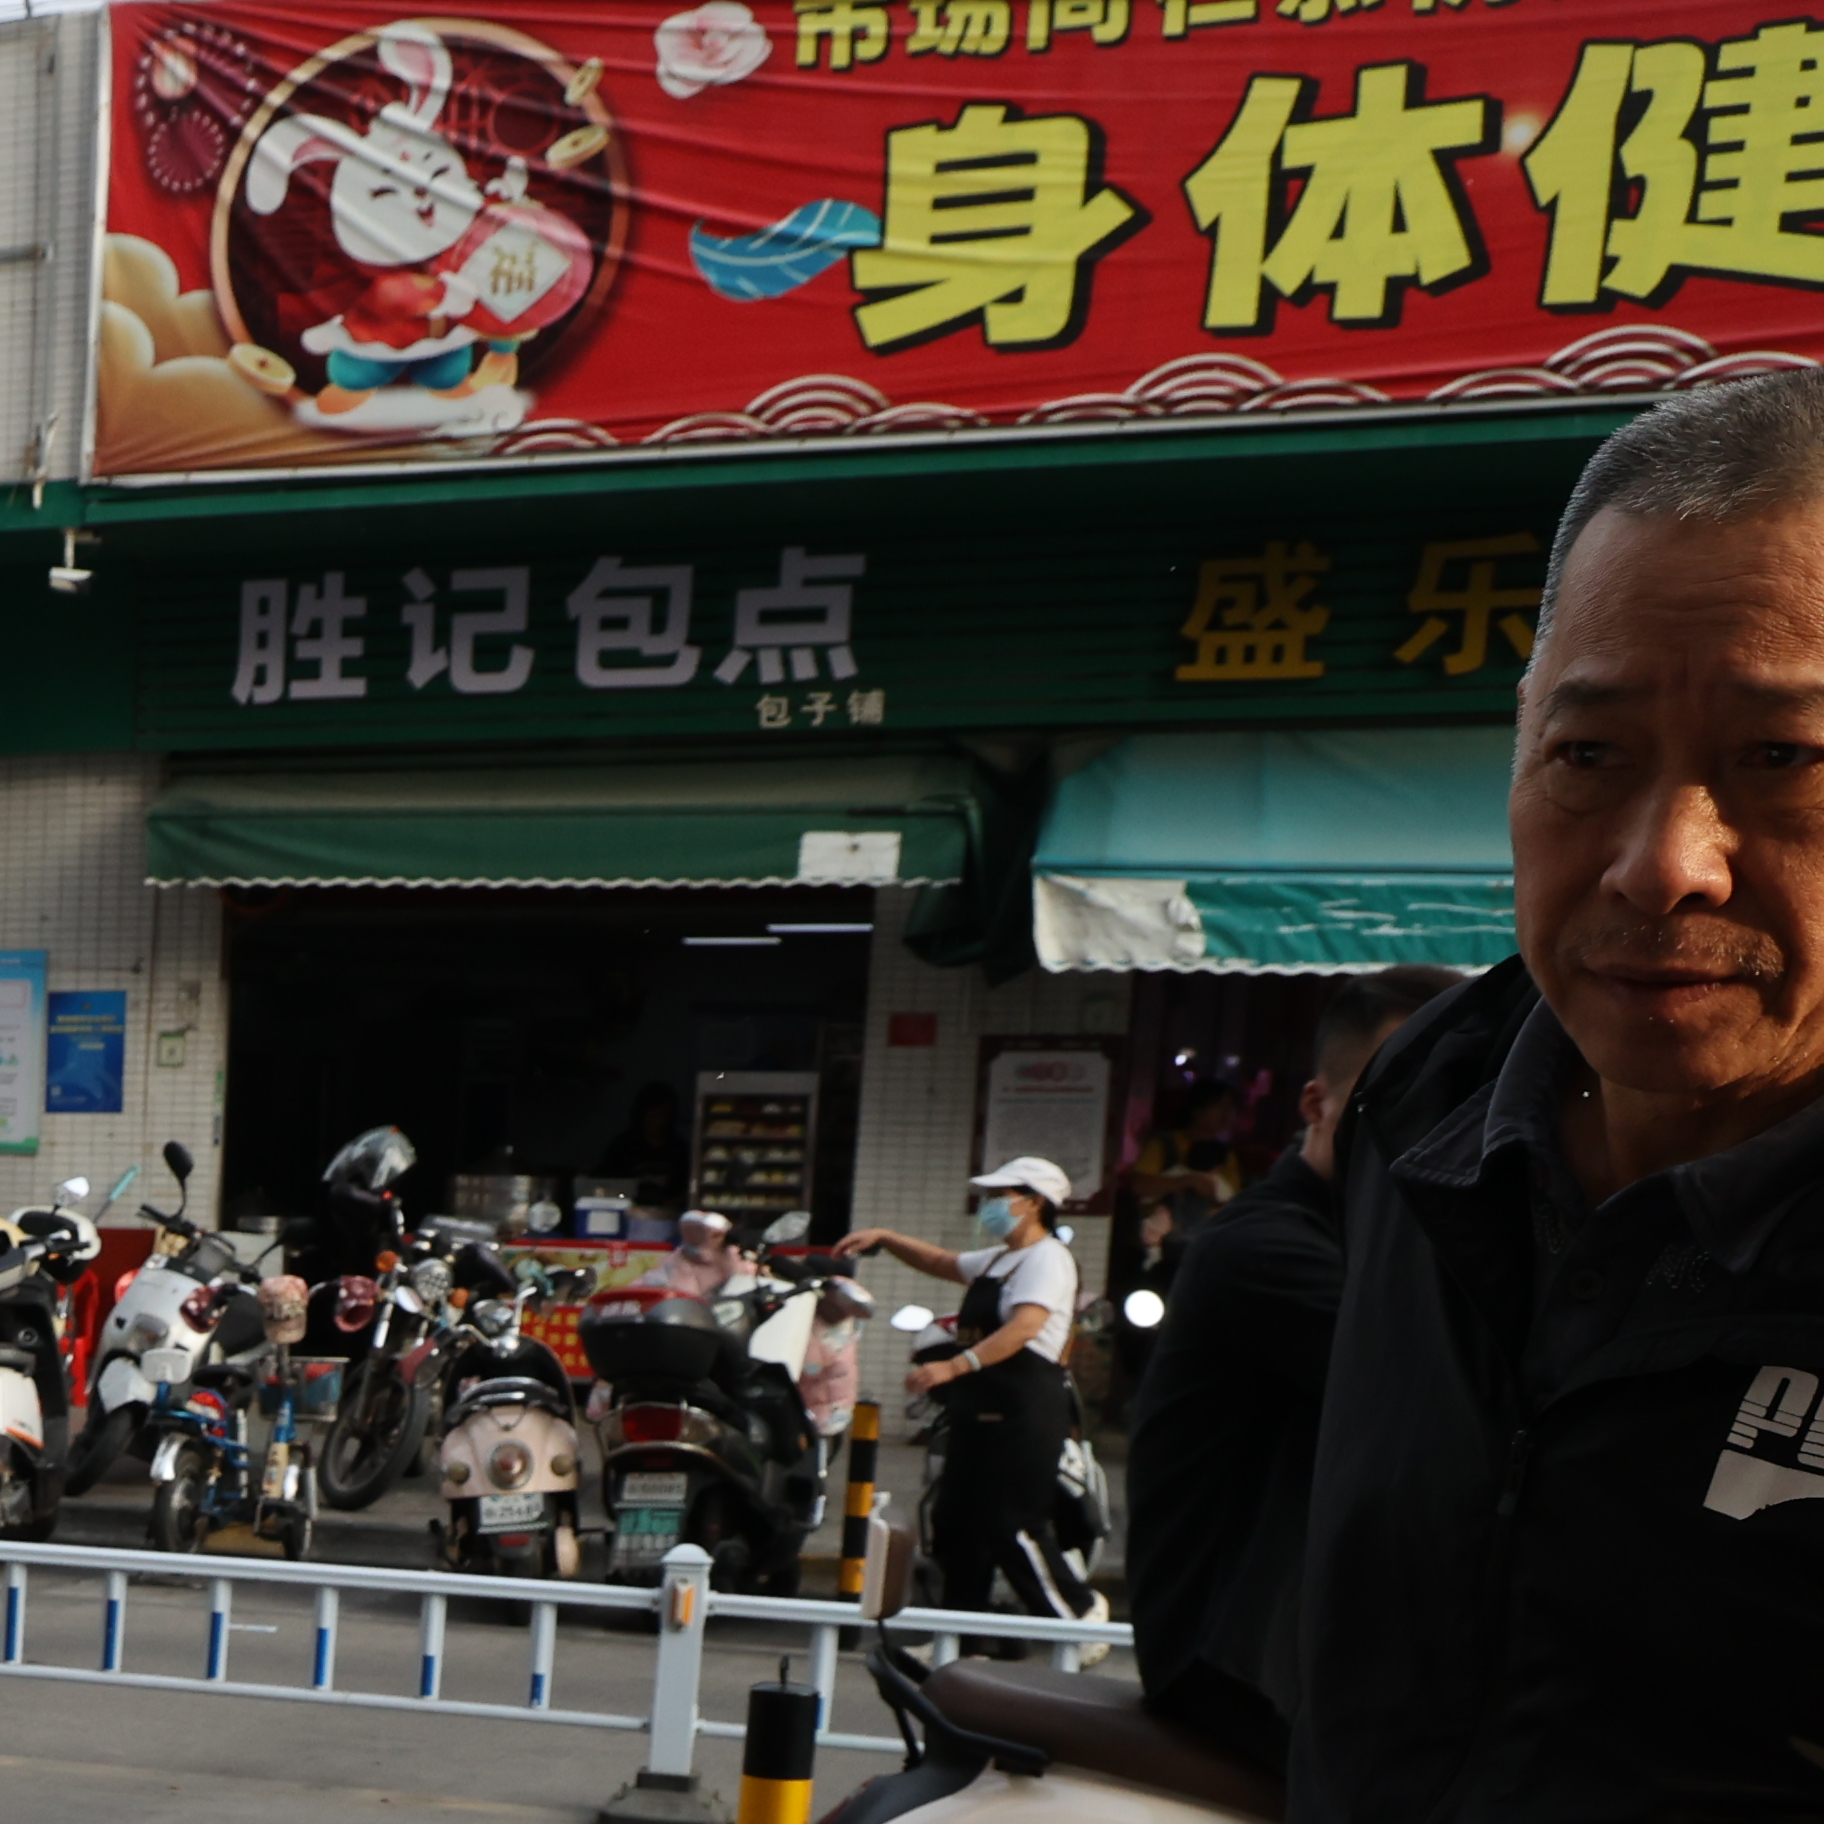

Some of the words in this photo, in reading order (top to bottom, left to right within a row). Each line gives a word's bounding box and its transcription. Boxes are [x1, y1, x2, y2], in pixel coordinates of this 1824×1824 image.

[851, 20, 1824, 350] 身体健
[230, 547, 867, 705] 胜记包点
[755, 689, 886, 728] 包子铺
